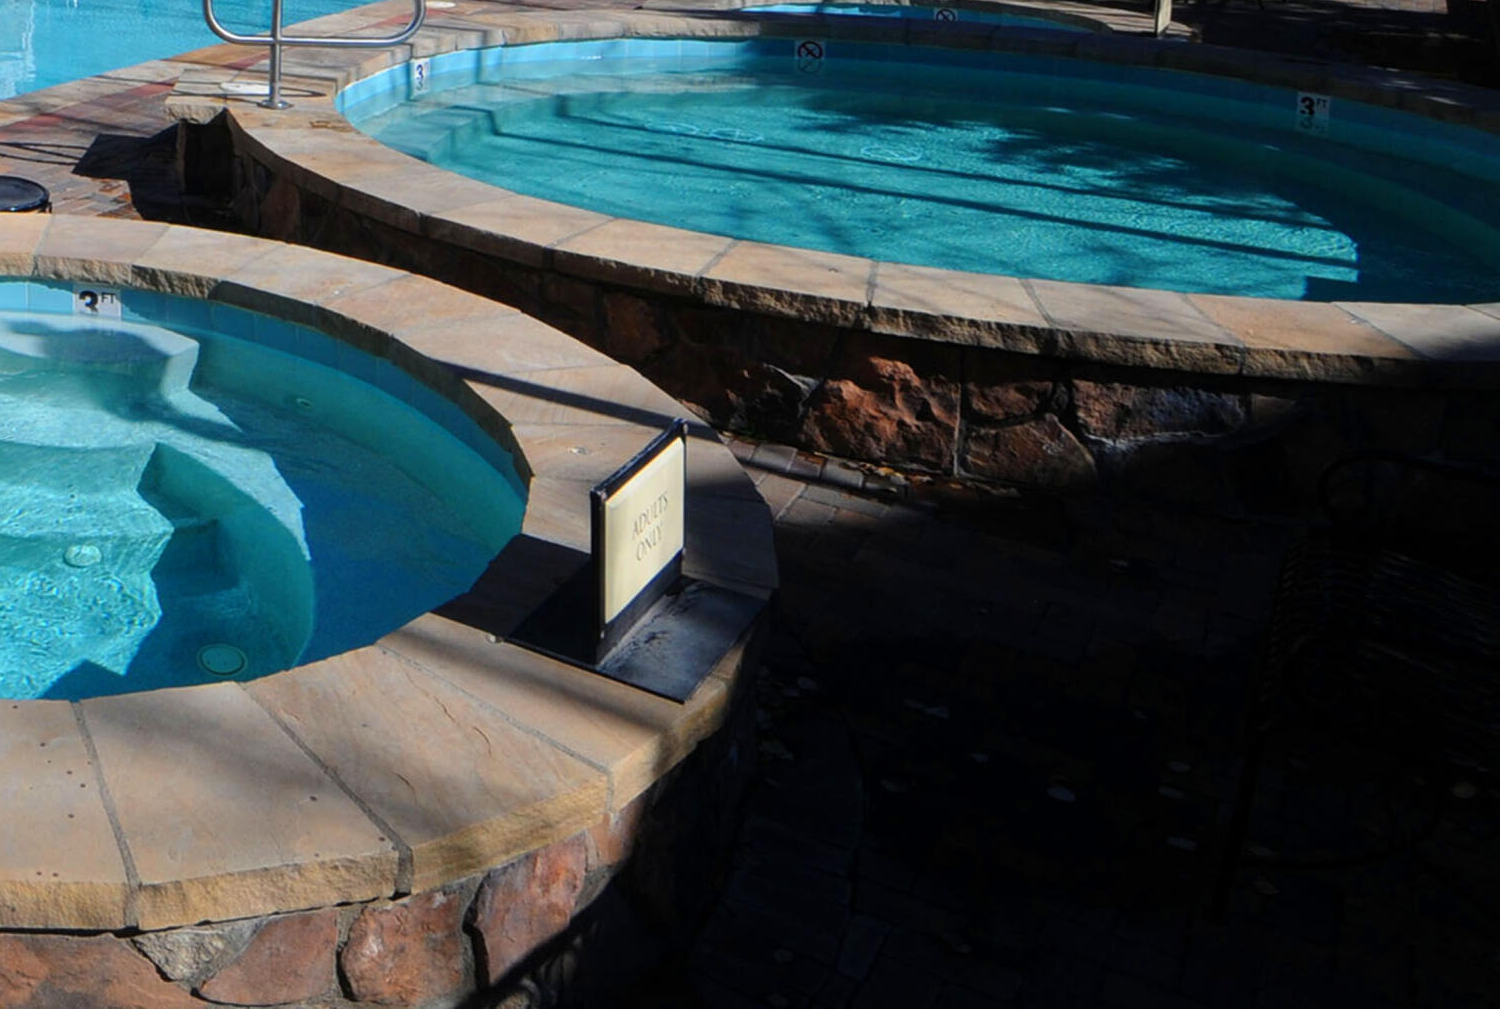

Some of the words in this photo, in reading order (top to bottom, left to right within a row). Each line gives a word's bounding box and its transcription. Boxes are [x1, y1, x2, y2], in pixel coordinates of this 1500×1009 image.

[416, 64, 424, 80] 3
[1300, 96, 1315, 115] 3
[101, 291, 116, 304] FT
[631, 492, 668, 540] ADULTS
[636, 522, 664, 562] ONLY
